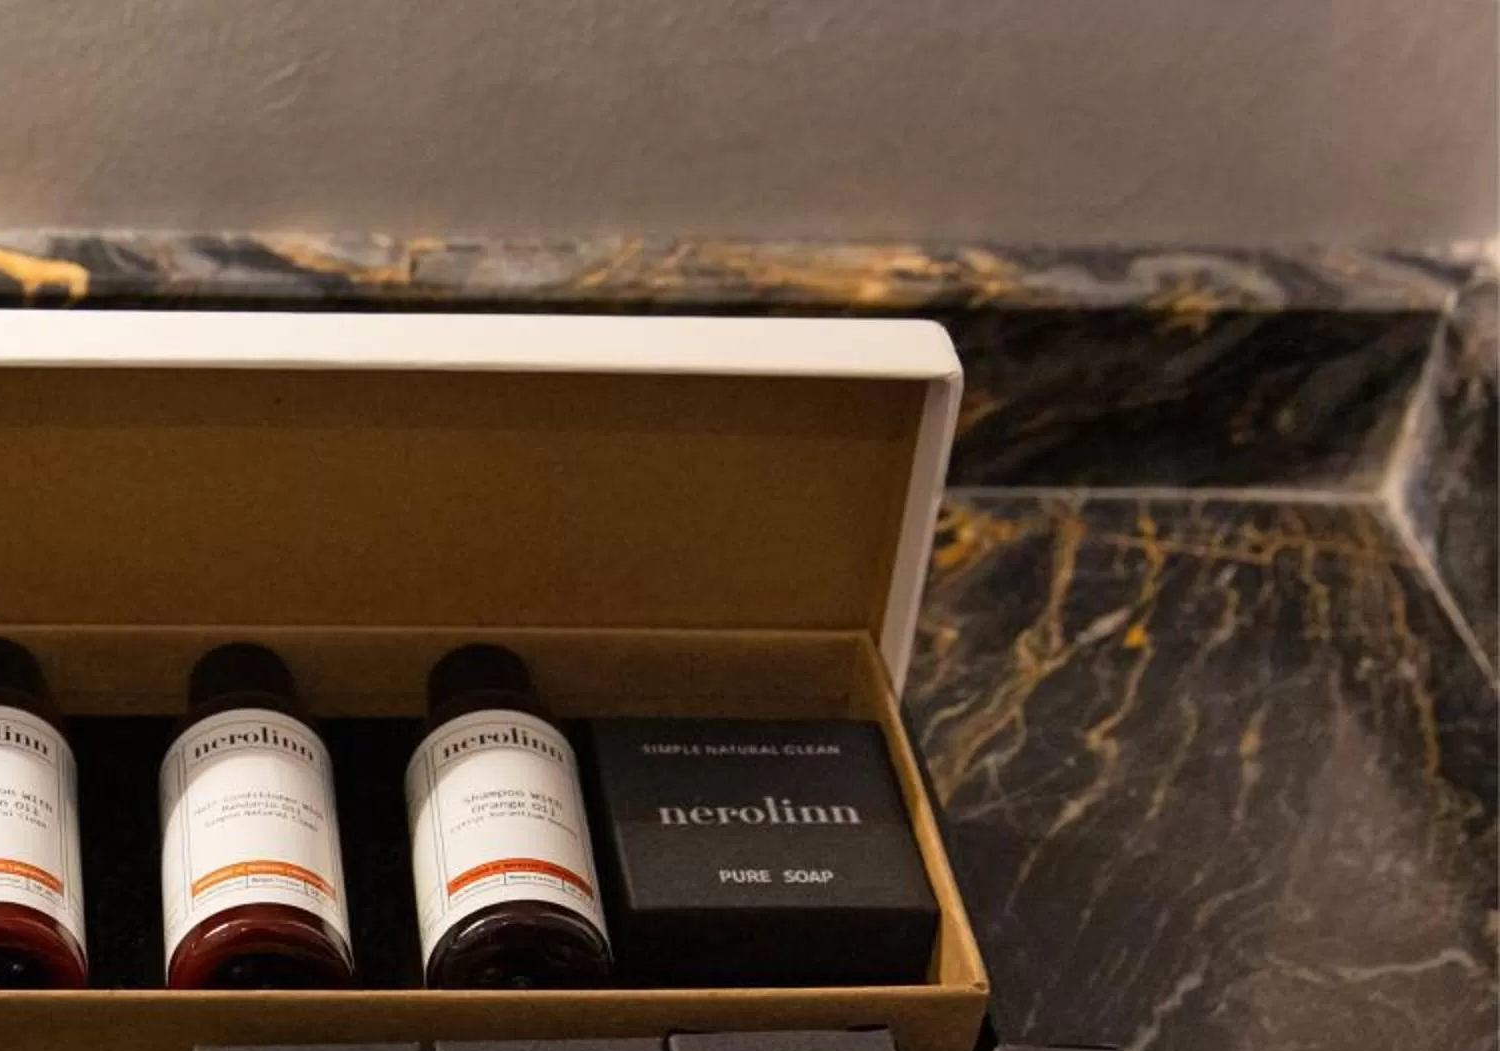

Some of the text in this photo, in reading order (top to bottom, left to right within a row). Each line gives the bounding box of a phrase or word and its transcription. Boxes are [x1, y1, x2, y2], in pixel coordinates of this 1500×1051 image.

[193, 725, 315, 762] nerolinn
[443, 726, 565, 764] nerolinn
[642, 743, 841, 756] SIMPLE NATURAL CLEAN
[657, 796, 862, 826] nerolinn
[717, 868, 835, 884] PURE SOAP
